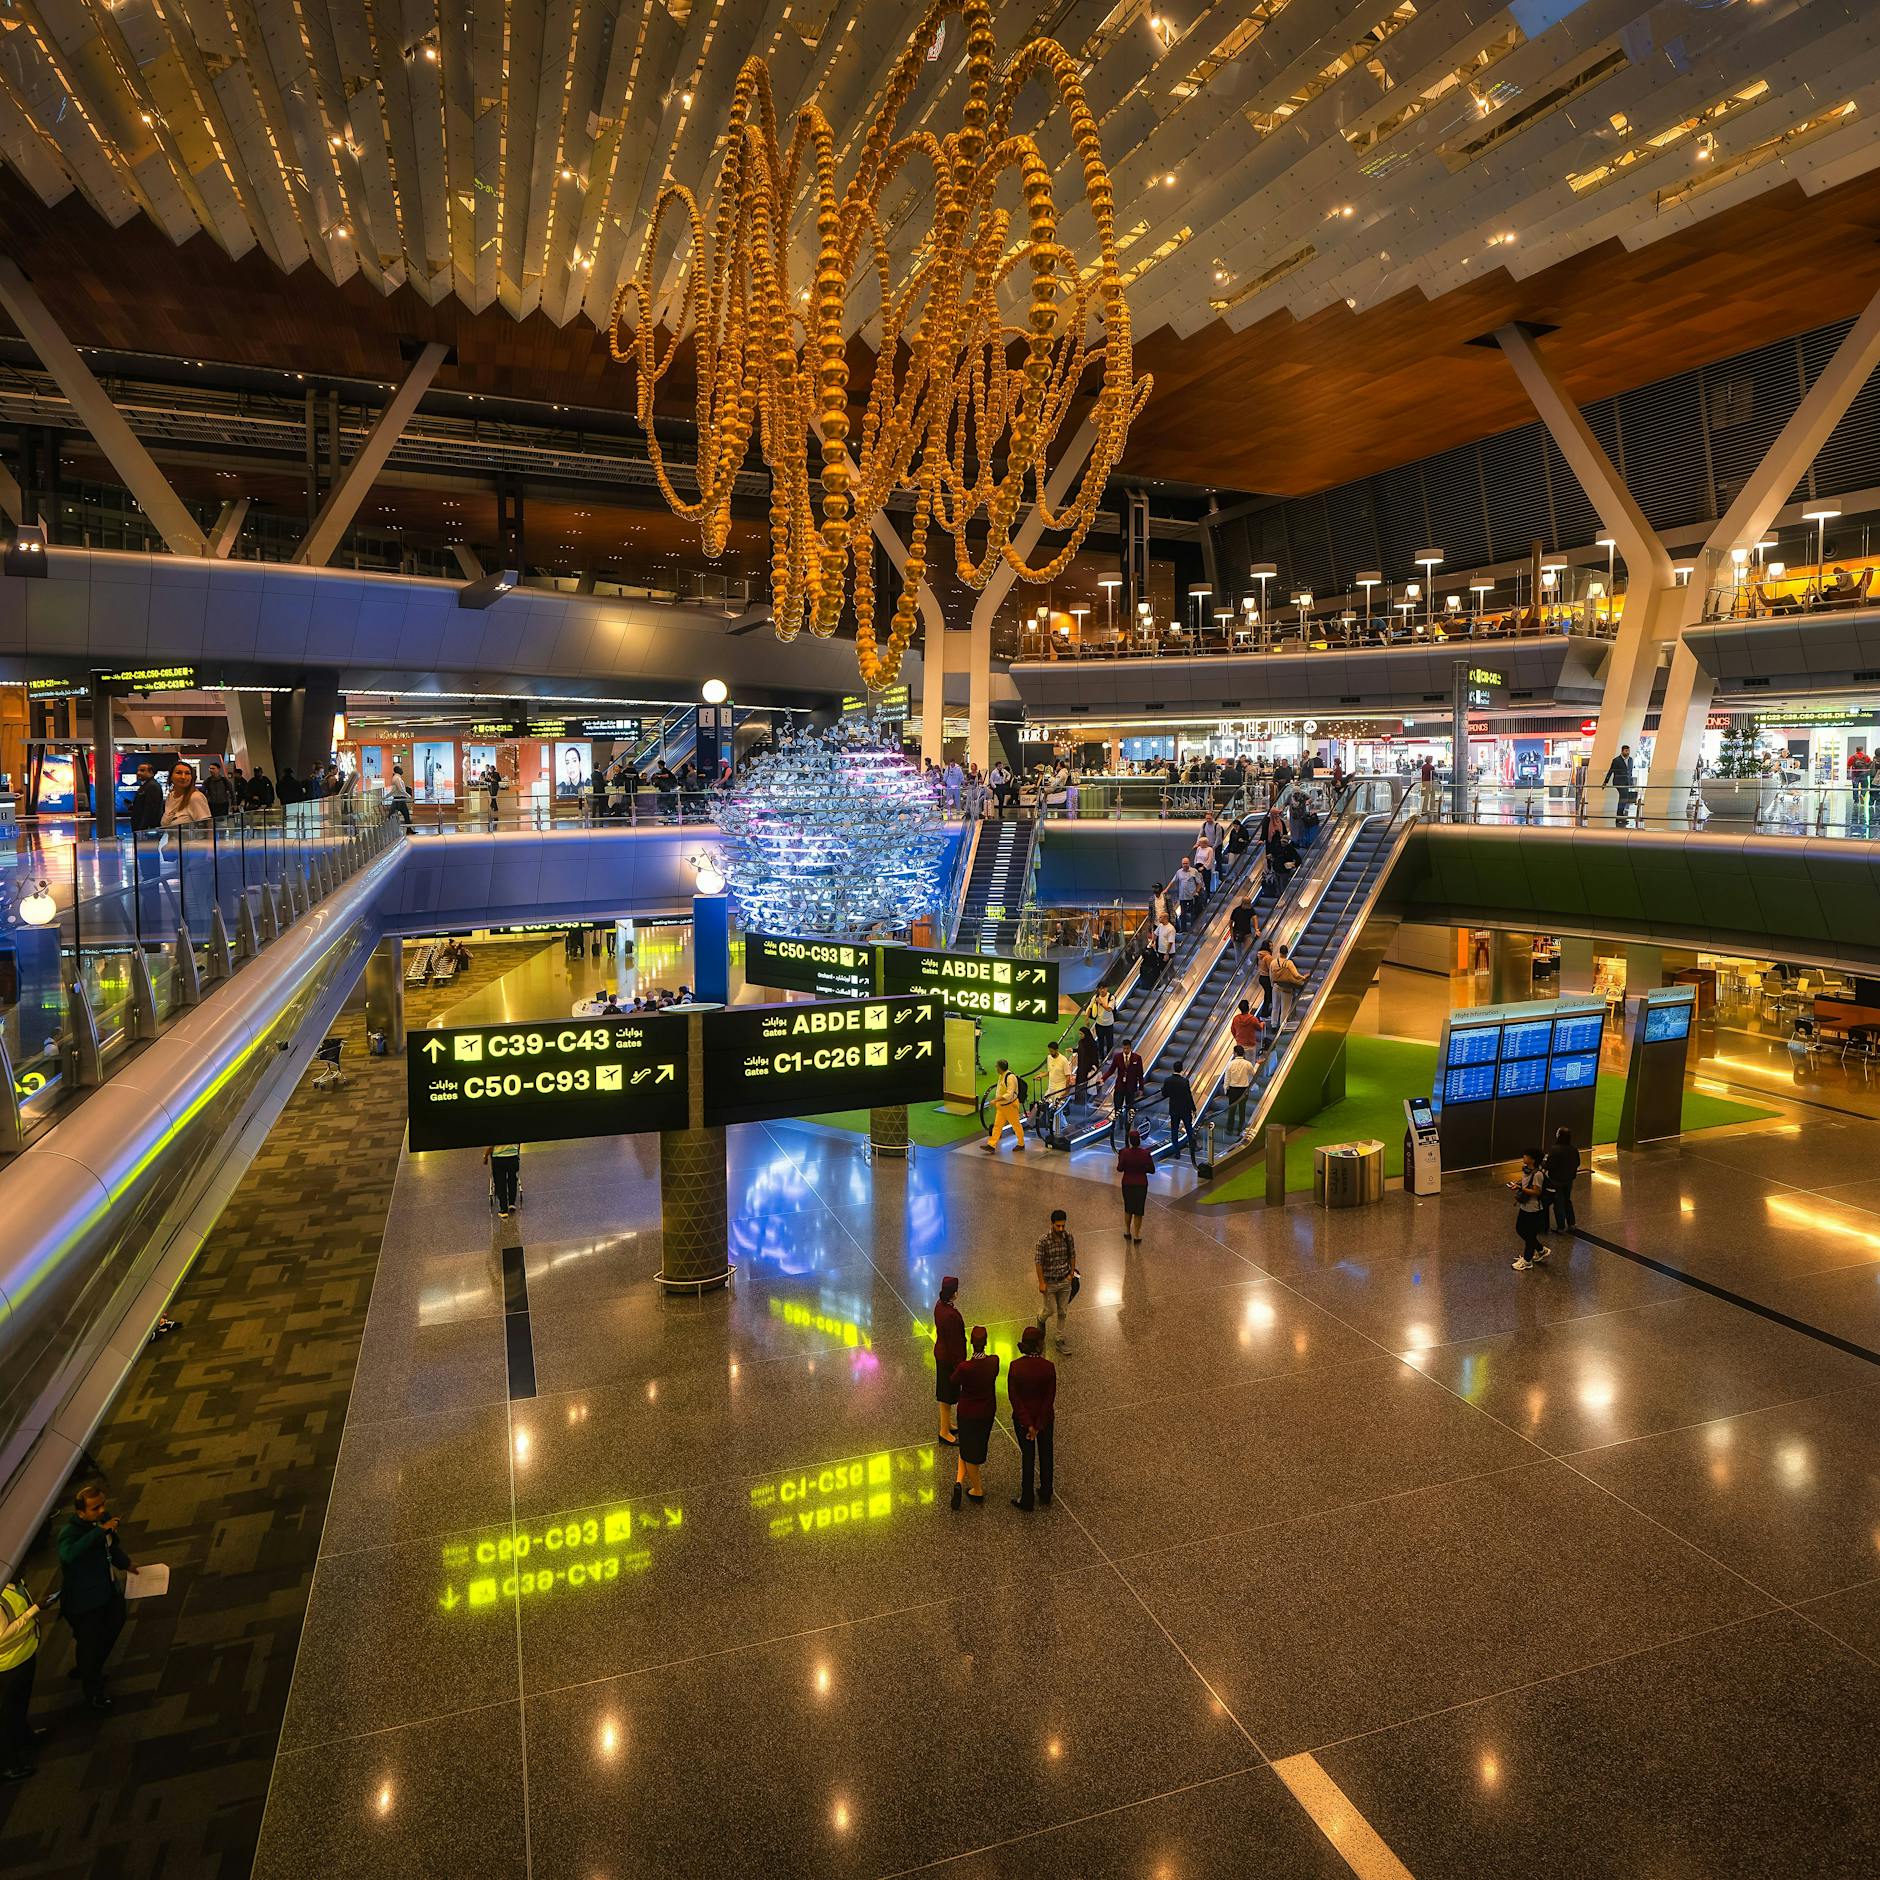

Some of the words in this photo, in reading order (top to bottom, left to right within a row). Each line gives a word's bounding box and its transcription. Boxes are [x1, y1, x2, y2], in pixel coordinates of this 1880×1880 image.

[1265, 720, 1296, 735] JUICE
[778, 941, 838, 964] C50-C93
[941, 960, 990, 980] ABDE
[763, 1028, 787, 1037] Gates
[792, 1009, 861, 1035] ABDE
[488, 1028, 610, 1057] C39-C43
[615, 1040, 642, 1049] Gates
[744, 1067, 769, 1077] Gates
[773, 1046, 861, 1073] C1-C26
[430, 1092, 458, 1102] Gates
[464, 1069, 590, 1099] C50-C93
